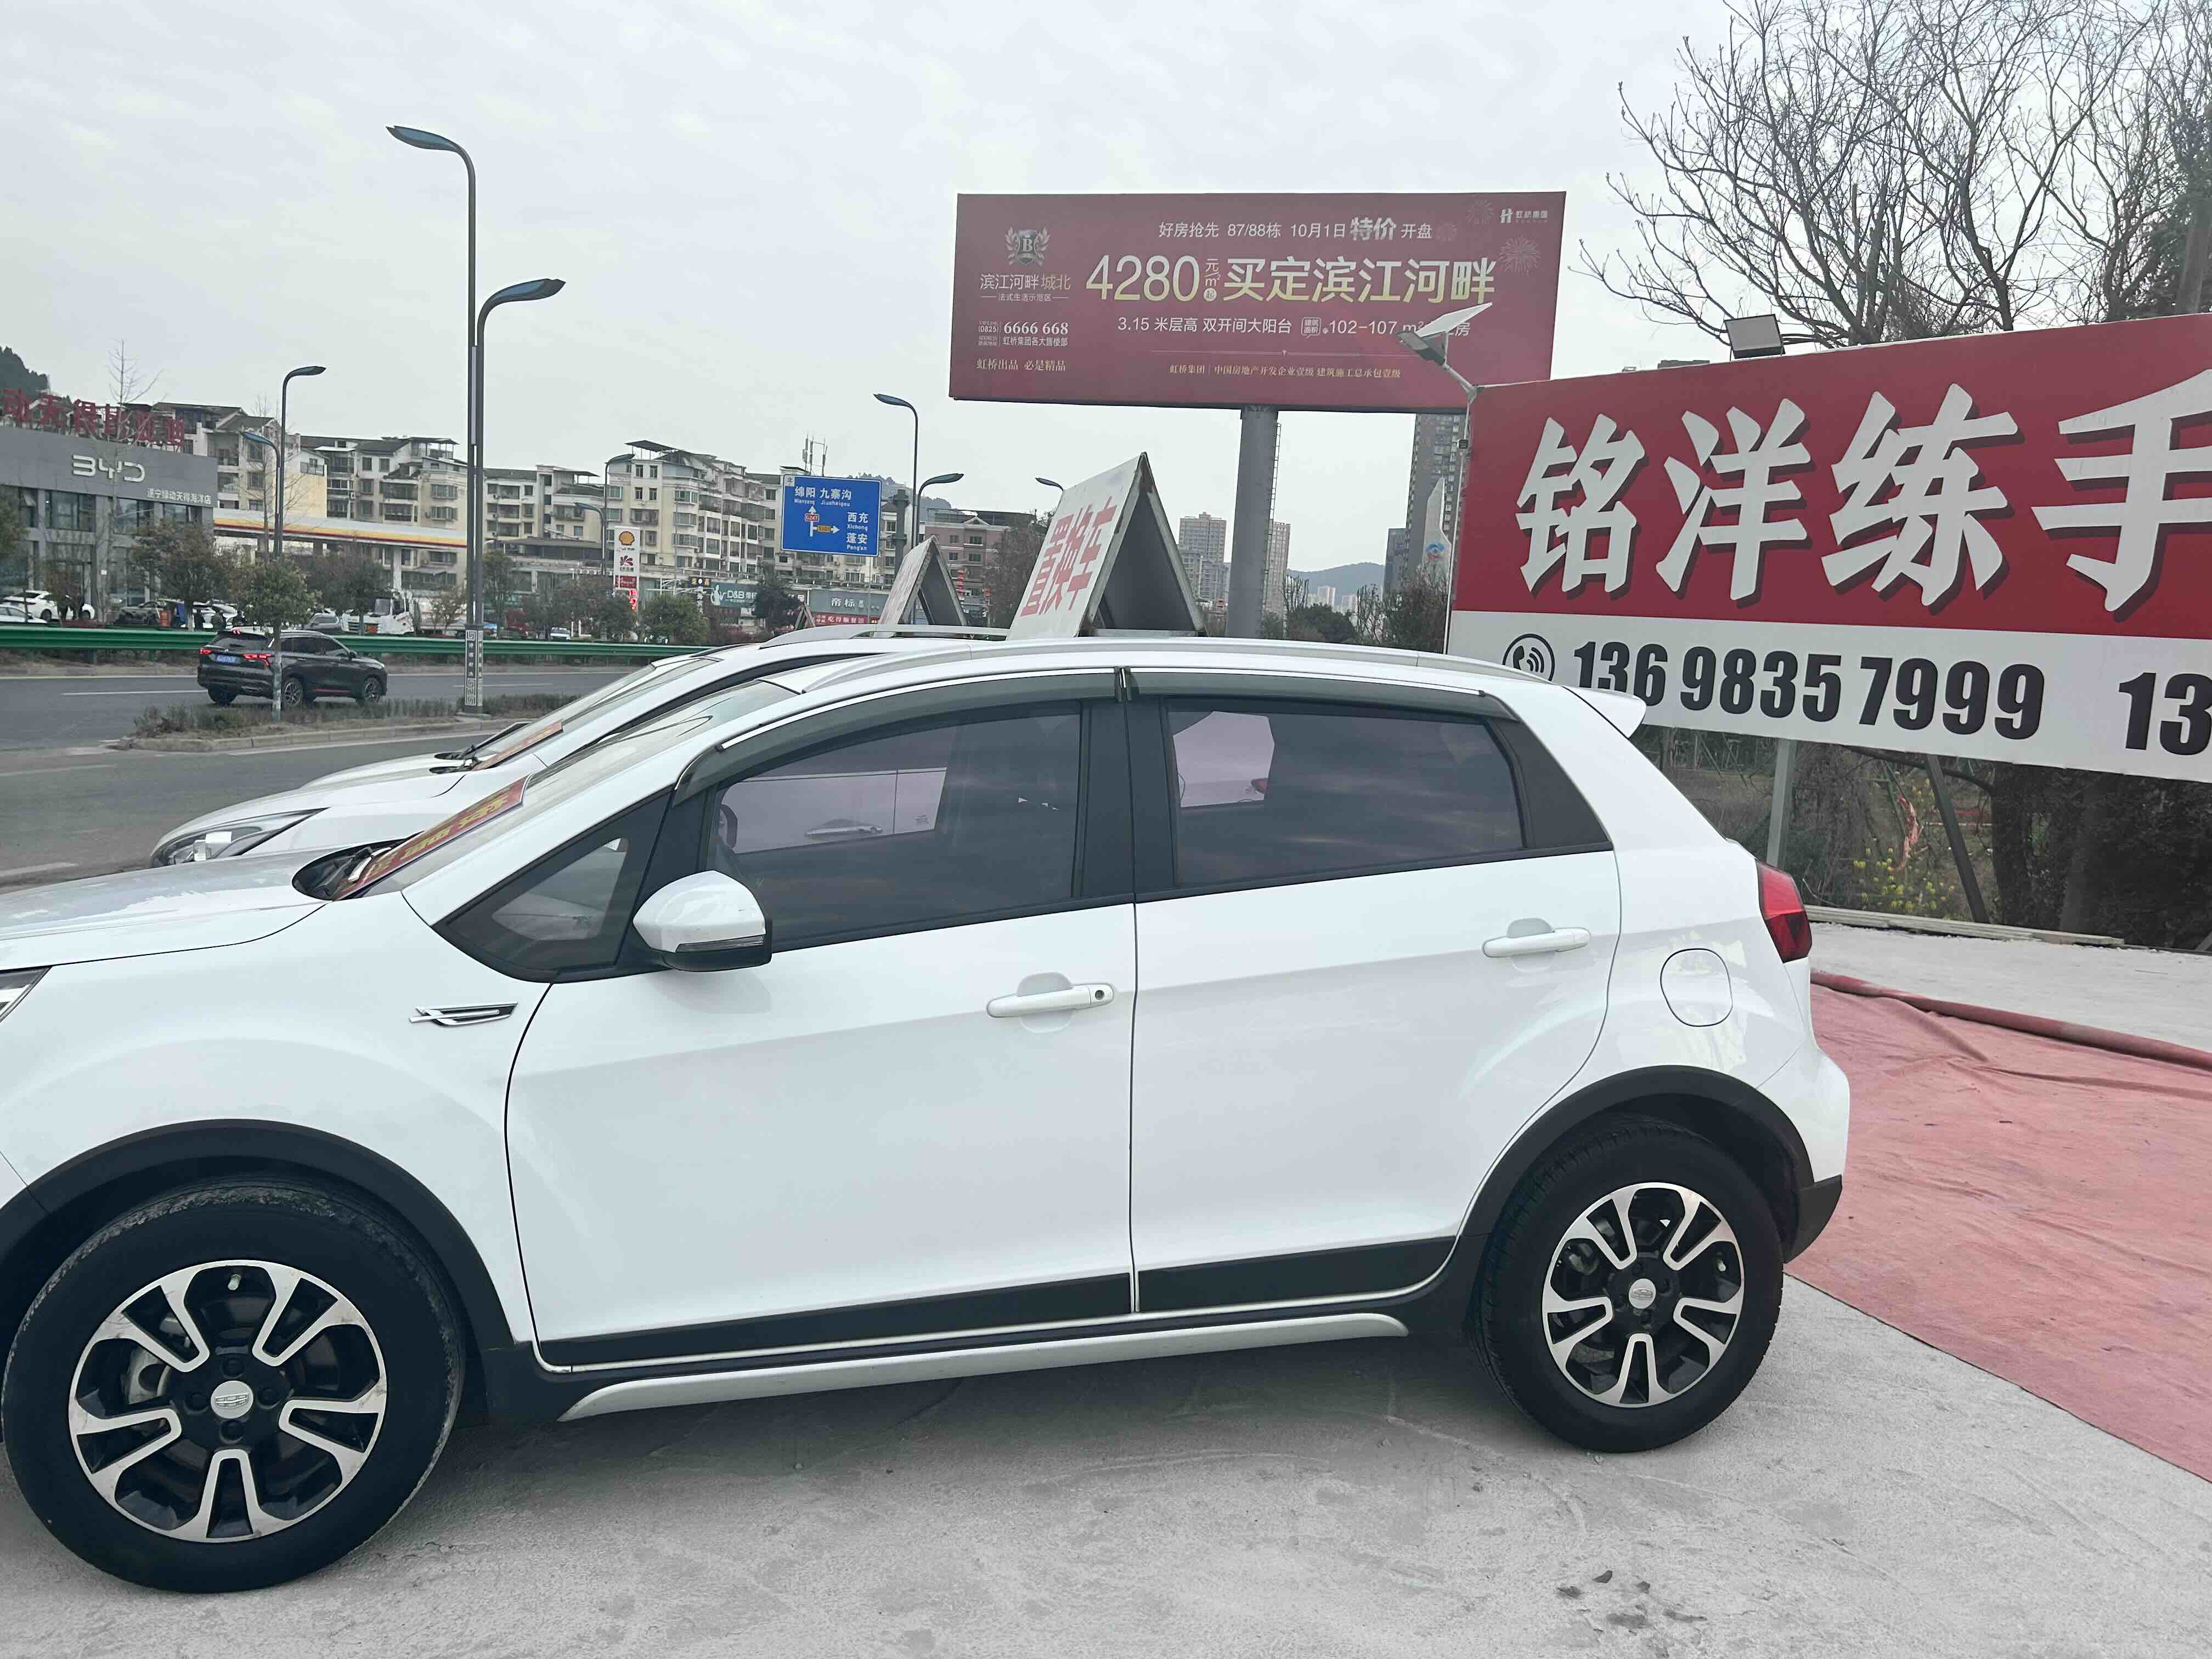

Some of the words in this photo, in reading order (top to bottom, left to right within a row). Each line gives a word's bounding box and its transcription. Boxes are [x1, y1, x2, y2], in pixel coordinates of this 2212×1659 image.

[1159, 222, 1220, 238] 好房抢先
[1227, 222, 1282, 238] 87/88栋
[1290, 223, 1345, 238] 10月1日
[1350, 217, 1397, 240] 特价
[1401, 223, 1432, 239] 开盘
[980, 274, 1039, 290] 滨江河畔
[1041, 274, 1071, 290] 城北
[1085, 255, 1200, 301] 4280
[1223, 256, 1497, 303] 买定滨江河畔
[1003, 321, 1038, 334] 6666
[1042, 322, 1069, 334] 668
[1118, 317, 1149, 330] 3.15
[1154, 318, 1198, 332] 米层高
[1203, 318, 1292, 334] 双开间大阳台
[73, 455, 145, 482] BYD
[795, 487, 815, 498] 绵阳
[820, 488, 851, 500] 九寨沟
[1516, 369, 2212, 612] 铭洋练手
[848, 512, 868, 523] 西充
[847, 533, 868, 544] 蓬安
[1573, 641, 1668, 707] 136
[1680, 646, 1842, 723] 9835
[1859, 656, 2045, 740] 7999
[2118, 672, 2212, 756] 13
